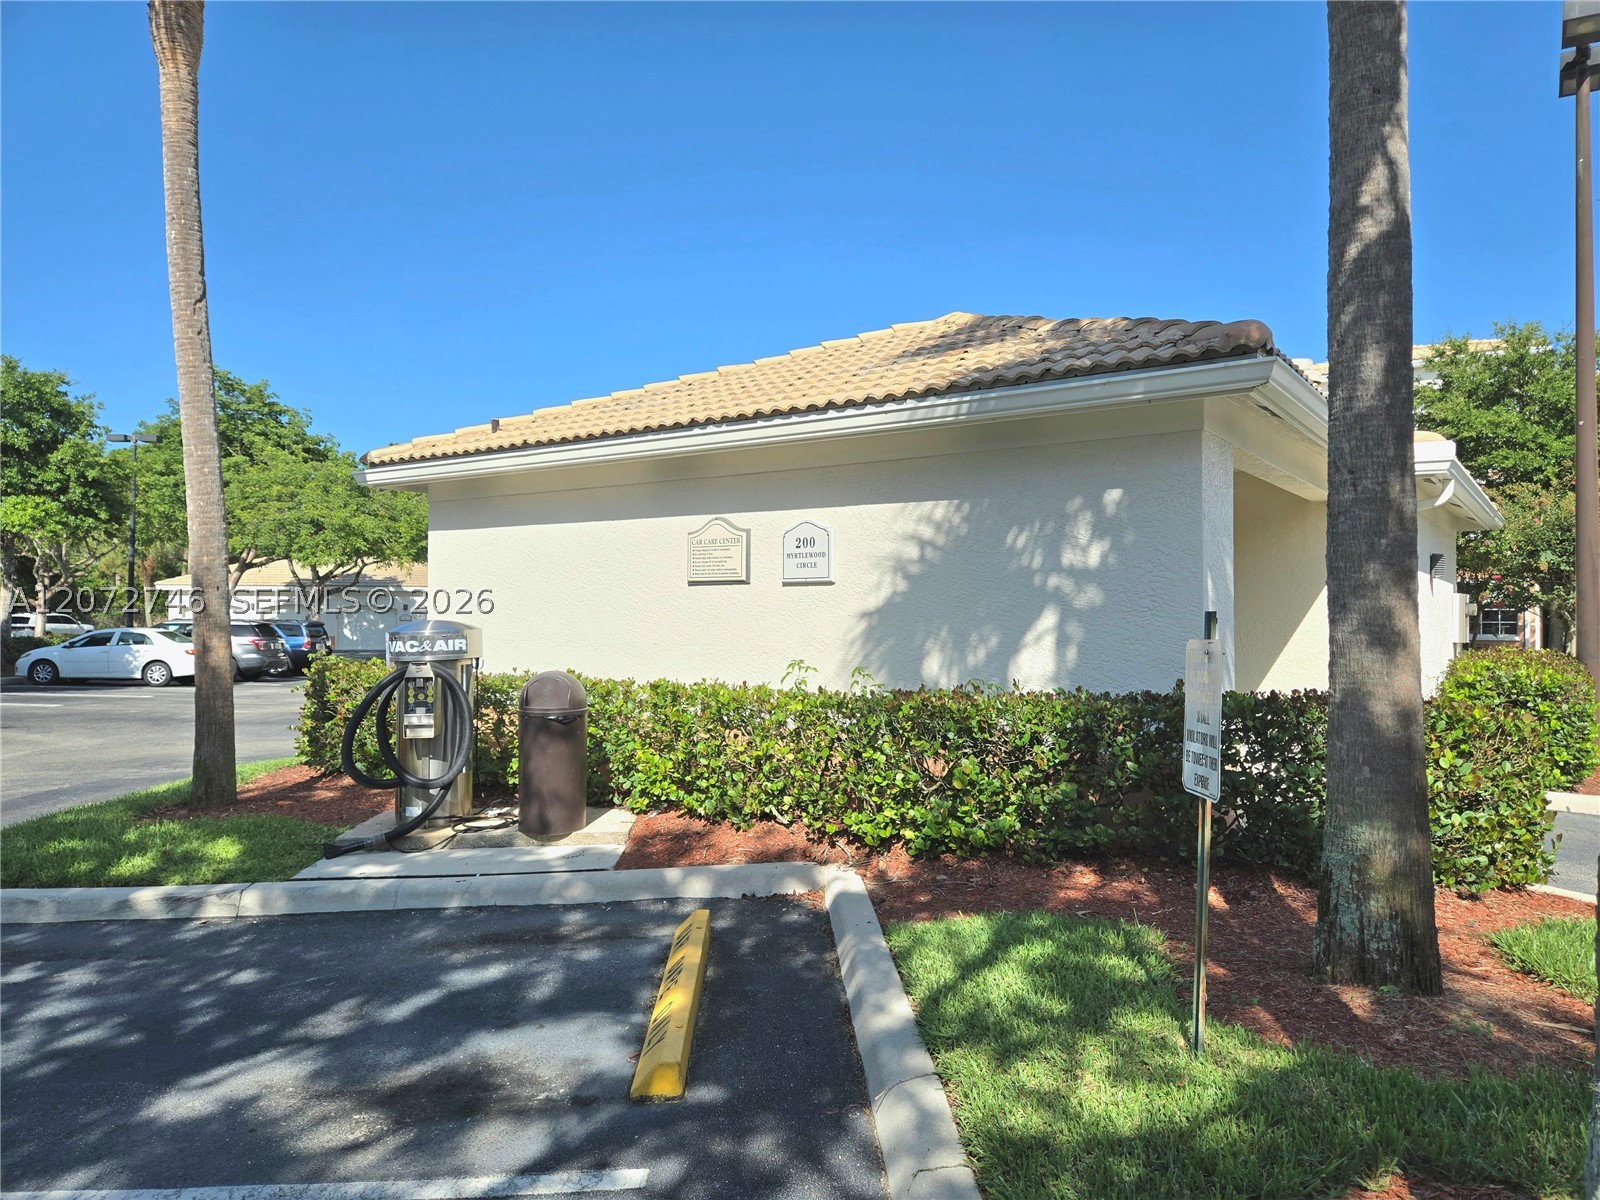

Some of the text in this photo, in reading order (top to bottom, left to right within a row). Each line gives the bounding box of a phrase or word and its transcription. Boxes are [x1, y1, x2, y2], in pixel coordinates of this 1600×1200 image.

[691, 538, 703, 546] CAR
[719, 537, 741, 545] CENTER
[795, 536, 816, 549] 200
[786, 551, 827, 560] MYRTLEWOOD
[796, 561, 818, 569] CIRCLE
[388, 638, 468, 653] VAC&AIR
[1186, 728, 1218, 750] VIOLATORS WILL
[1185, 749, 1191, 763] BE
[659, 955, 686, 1001] CARE
[643, 1000, 674, 1057] ONLY
